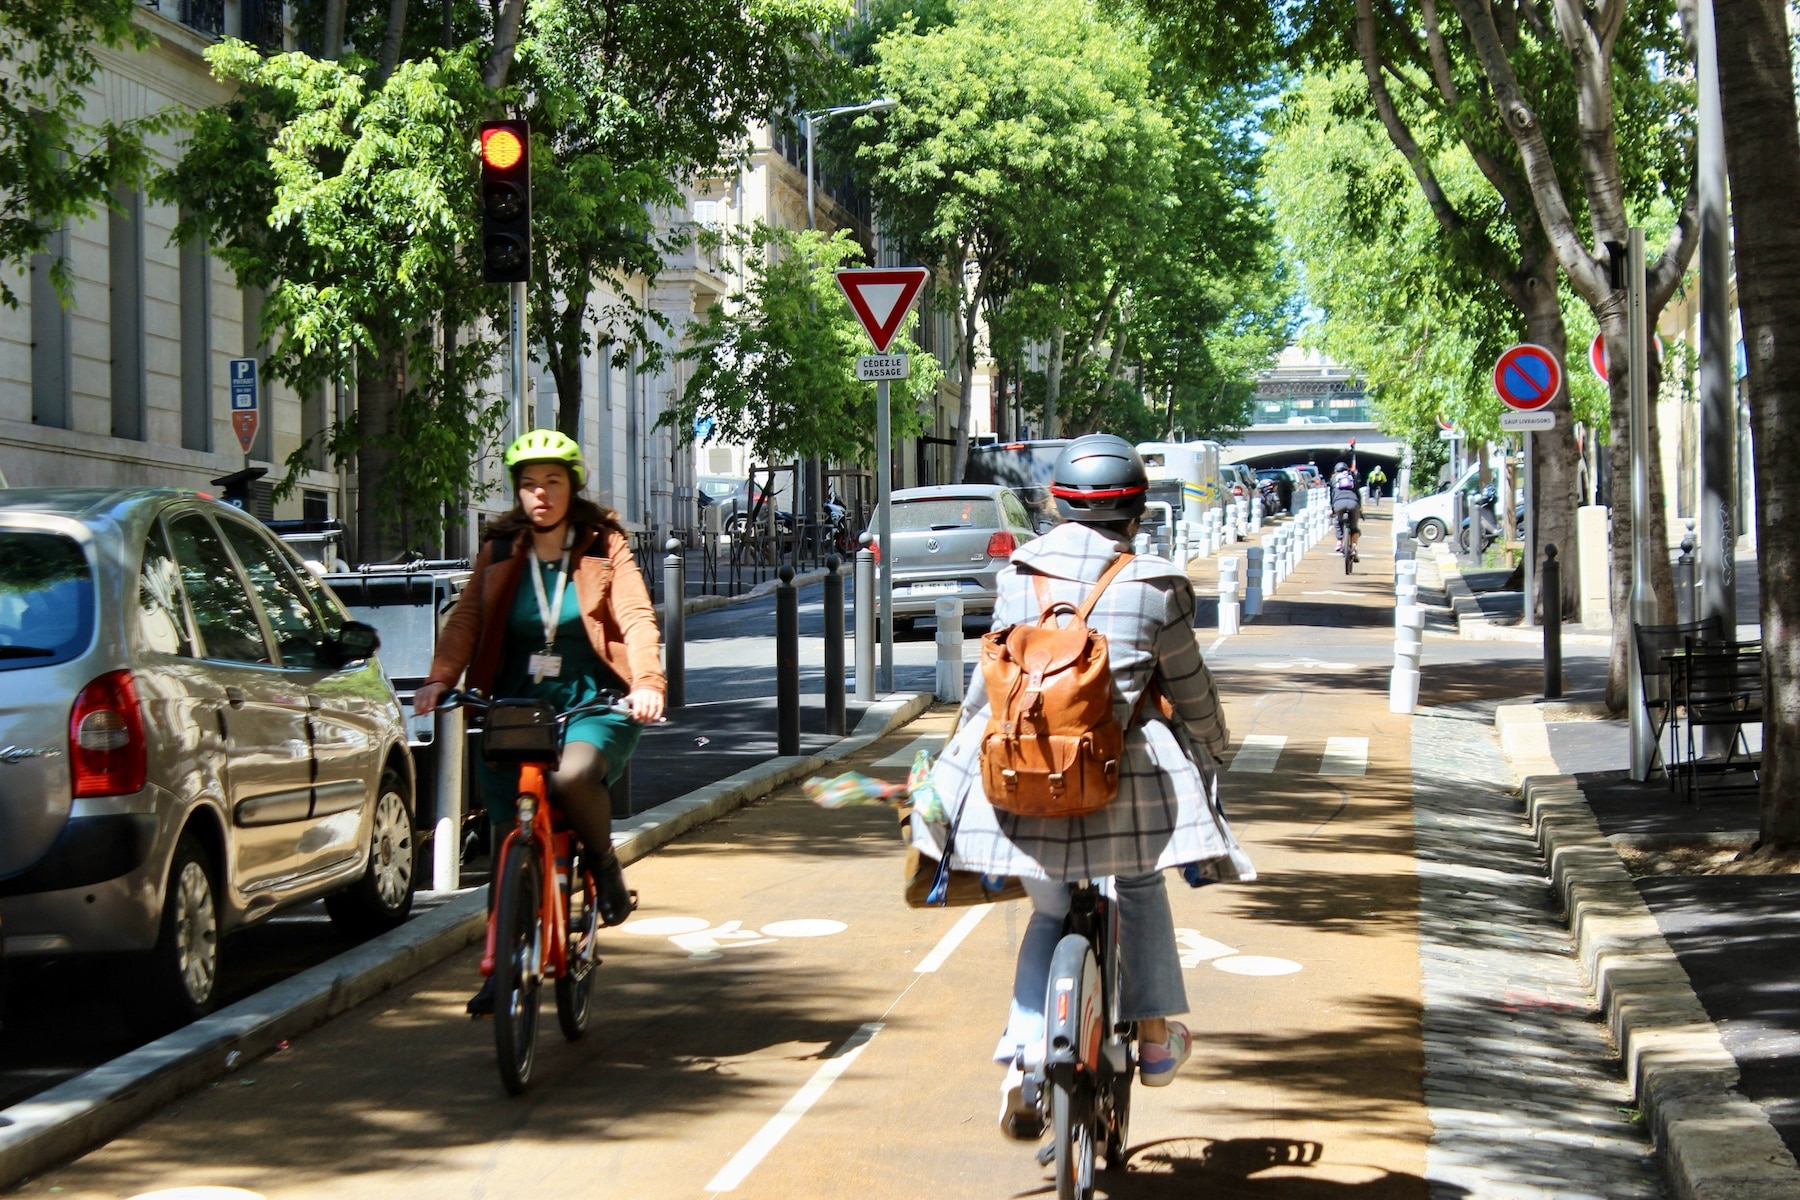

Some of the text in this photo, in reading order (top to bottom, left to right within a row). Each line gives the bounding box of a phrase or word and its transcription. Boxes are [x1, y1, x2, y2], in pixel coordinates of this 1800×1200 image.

[864, 359, 901, 368] CÉDEZ LE
[238, 362, 249, 378] P
[864, 368, 901, 377] PASSAGE
